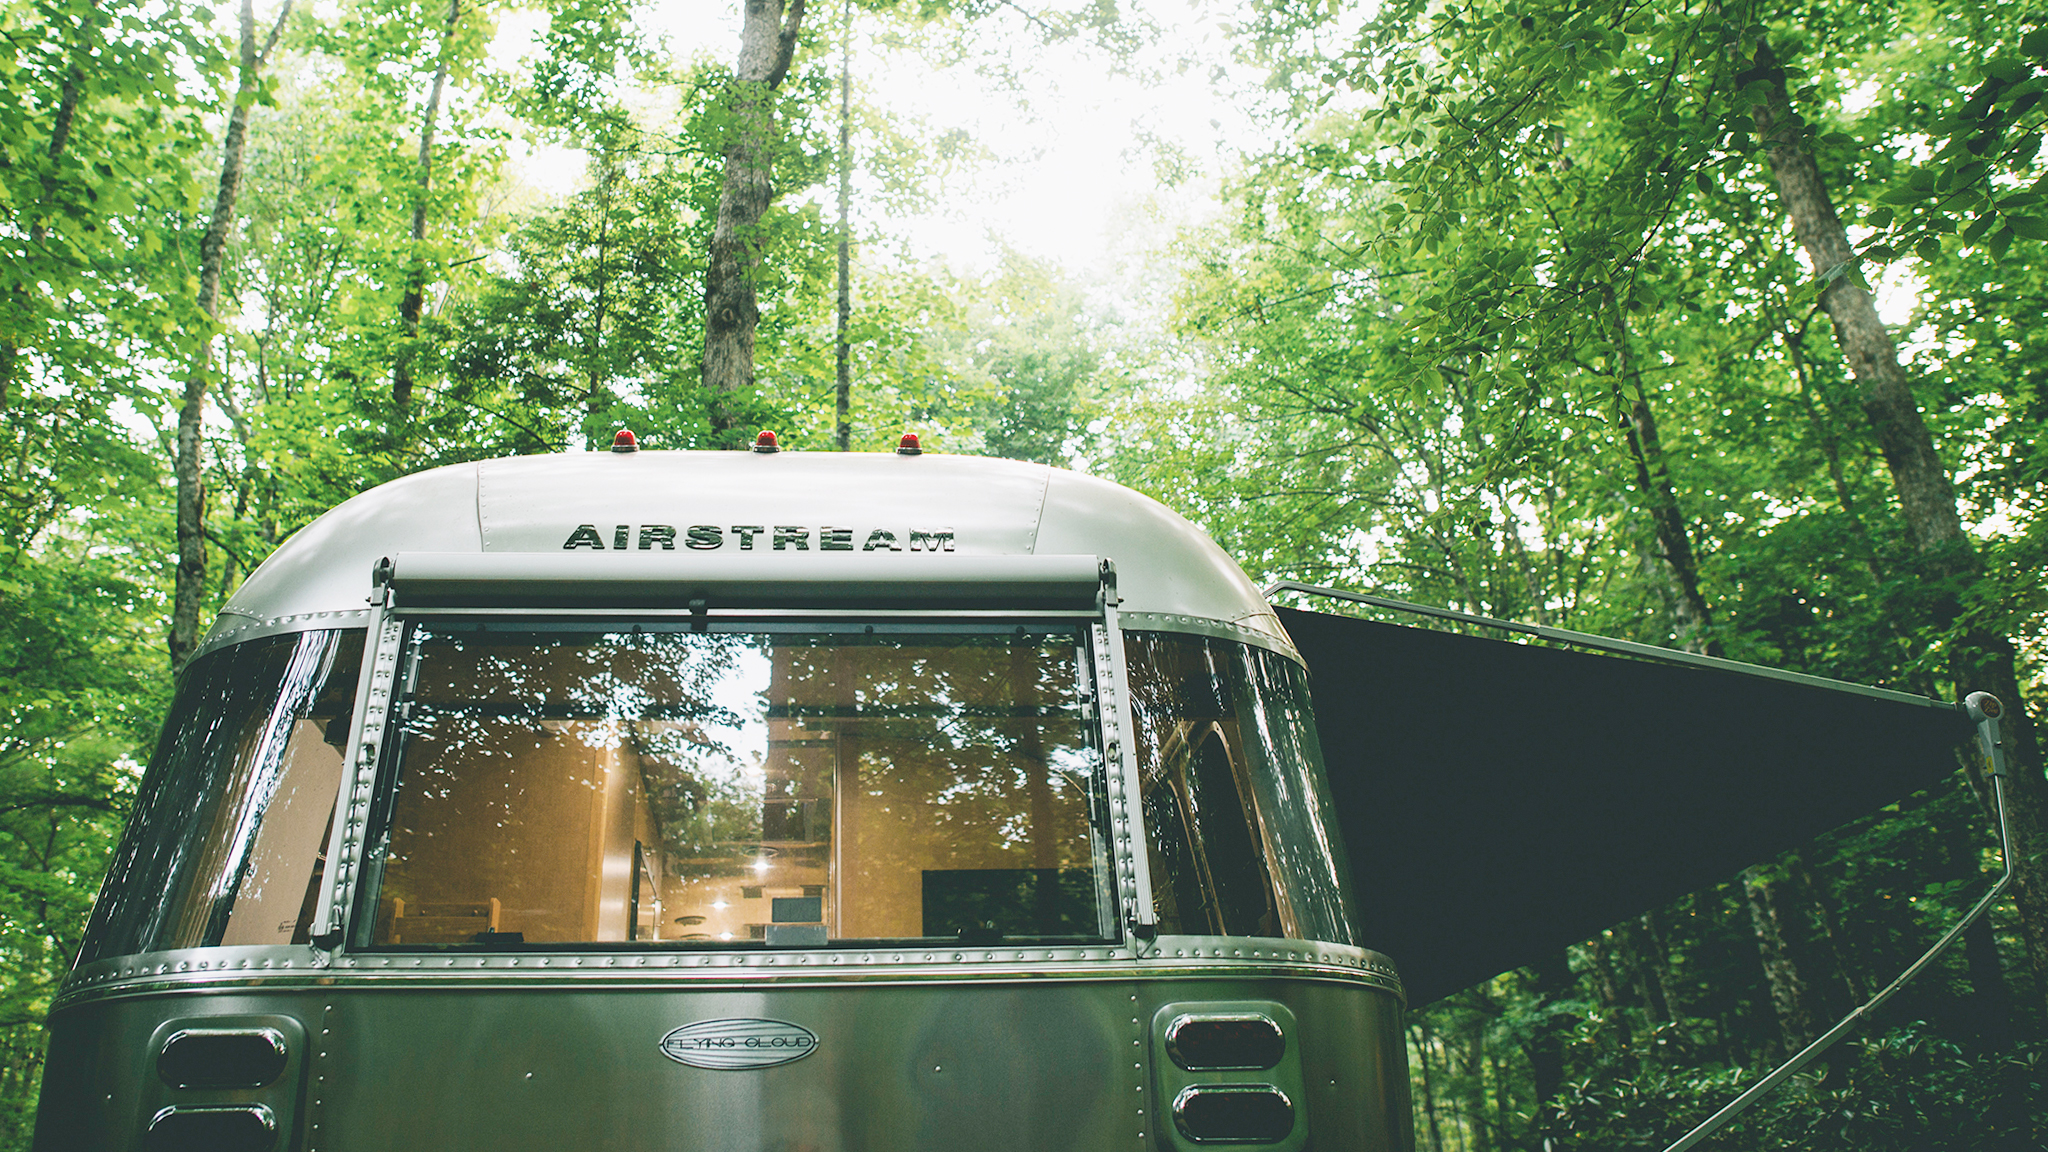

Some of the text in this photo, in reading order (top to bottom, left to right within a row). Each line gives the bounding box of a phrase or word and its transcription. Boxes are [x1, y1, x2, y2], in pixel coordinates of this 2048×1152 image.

[563, 524, 955, 552] AIRSTREAM
[666, 1037, 811, 1050] FLYING CLOUD
